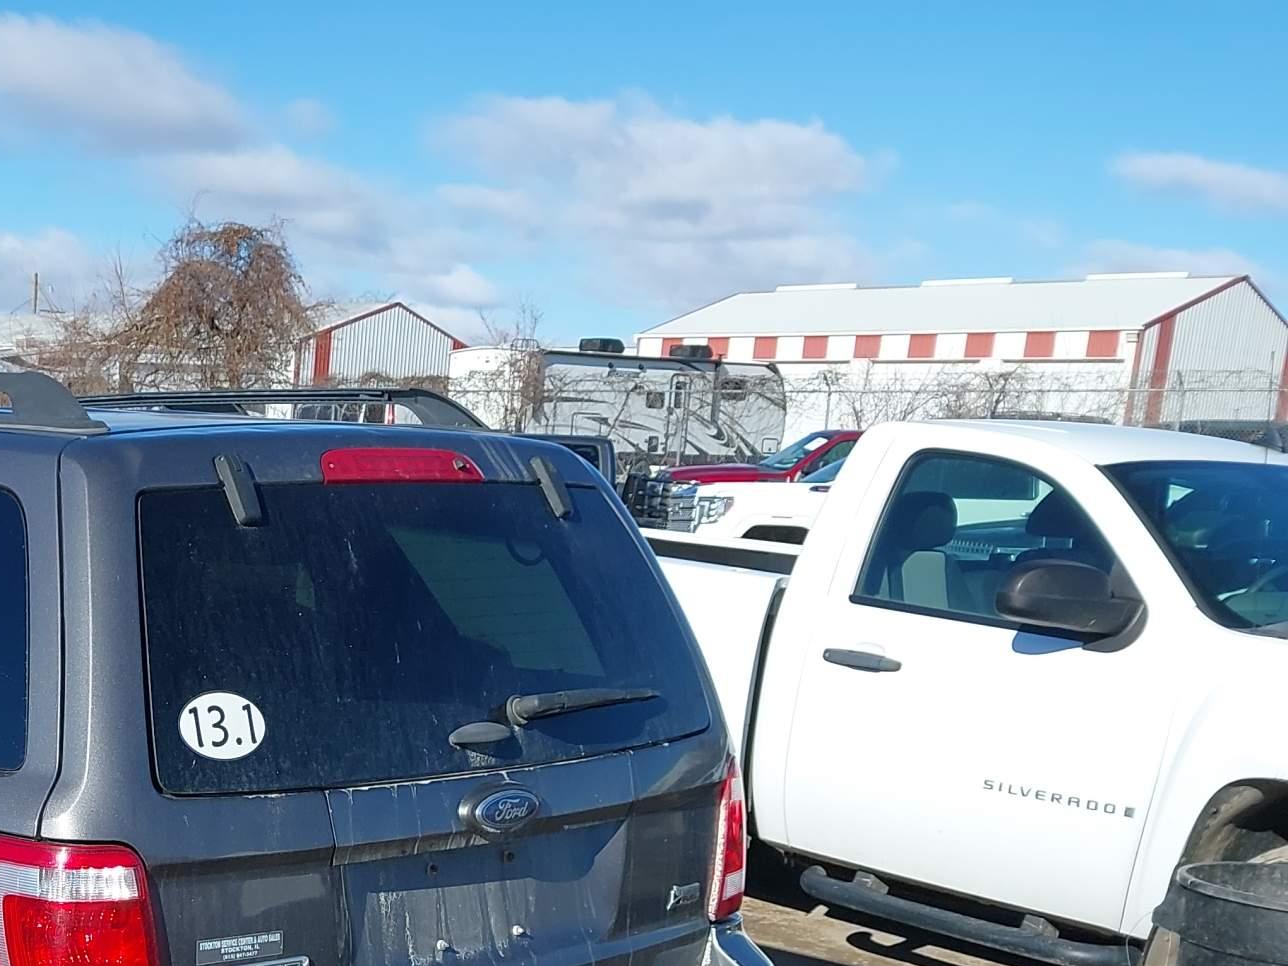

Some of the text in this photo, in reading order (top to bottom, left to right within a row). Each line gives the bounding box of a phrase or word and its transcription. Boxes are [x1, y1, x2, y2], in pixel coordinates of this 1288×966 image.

[189, 703, 257, 748] 13.1
[495, 798, 529, 821] Ford
[983, 779, 1116, 814] SILVERADO
[199, 941, 221, 951] STOCKTON
[221, 938, 238, 948] SERVICE
[238, 936, 253, 946] CENTER
[257, 934, 269, 943] AUTO
[268, 933, 281, 942] SALES
